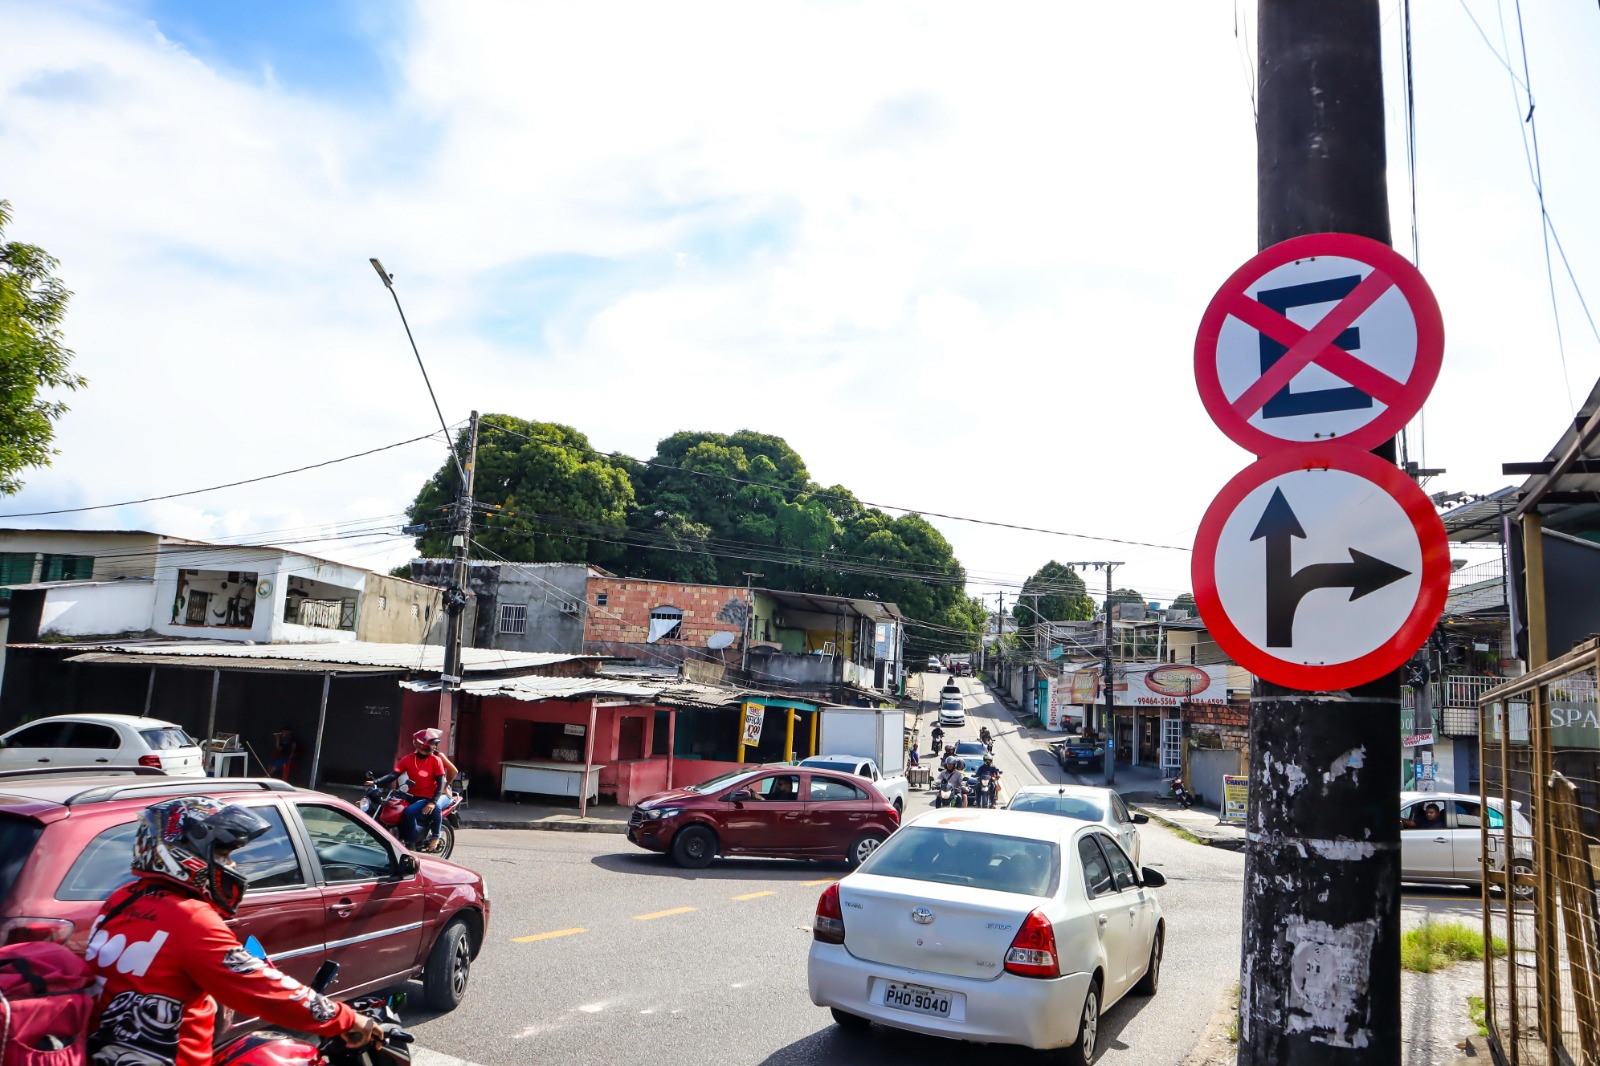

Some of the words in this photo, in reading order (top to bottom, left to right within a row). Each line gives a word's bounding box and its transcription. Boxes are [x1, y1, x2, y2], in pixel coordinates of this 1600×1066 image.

[1257, 274, 1373, 419] E
[1137, 697, 1177, 706] 99464-5566
[1549, 707, 1600, 729] SPA
